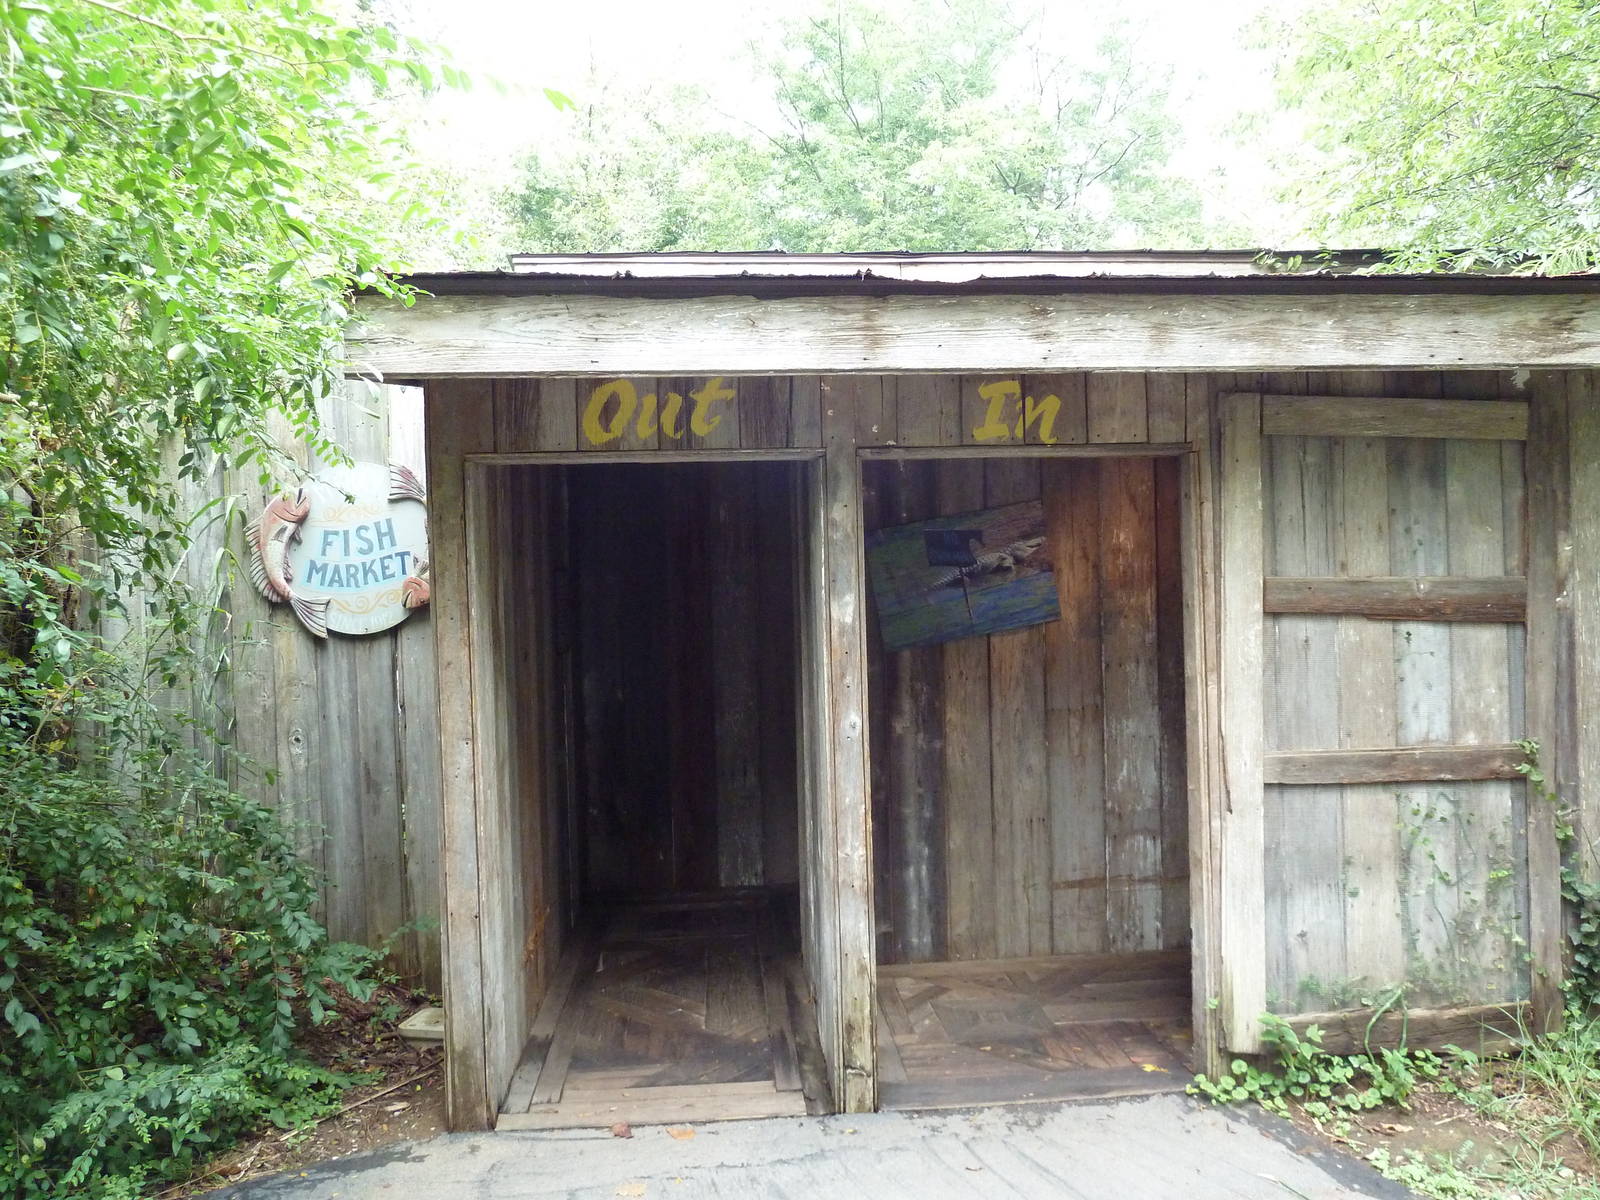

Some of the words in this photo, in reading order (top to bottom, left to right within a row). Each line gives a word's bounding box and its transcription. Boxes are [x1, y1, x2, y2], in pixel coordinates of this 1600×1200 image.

[582, 377, 736, 445] Out
[973, 380, 1061, 444] In
[320, 517, 397, 557] FISH
[306, 550, 411, 589] MARKET
